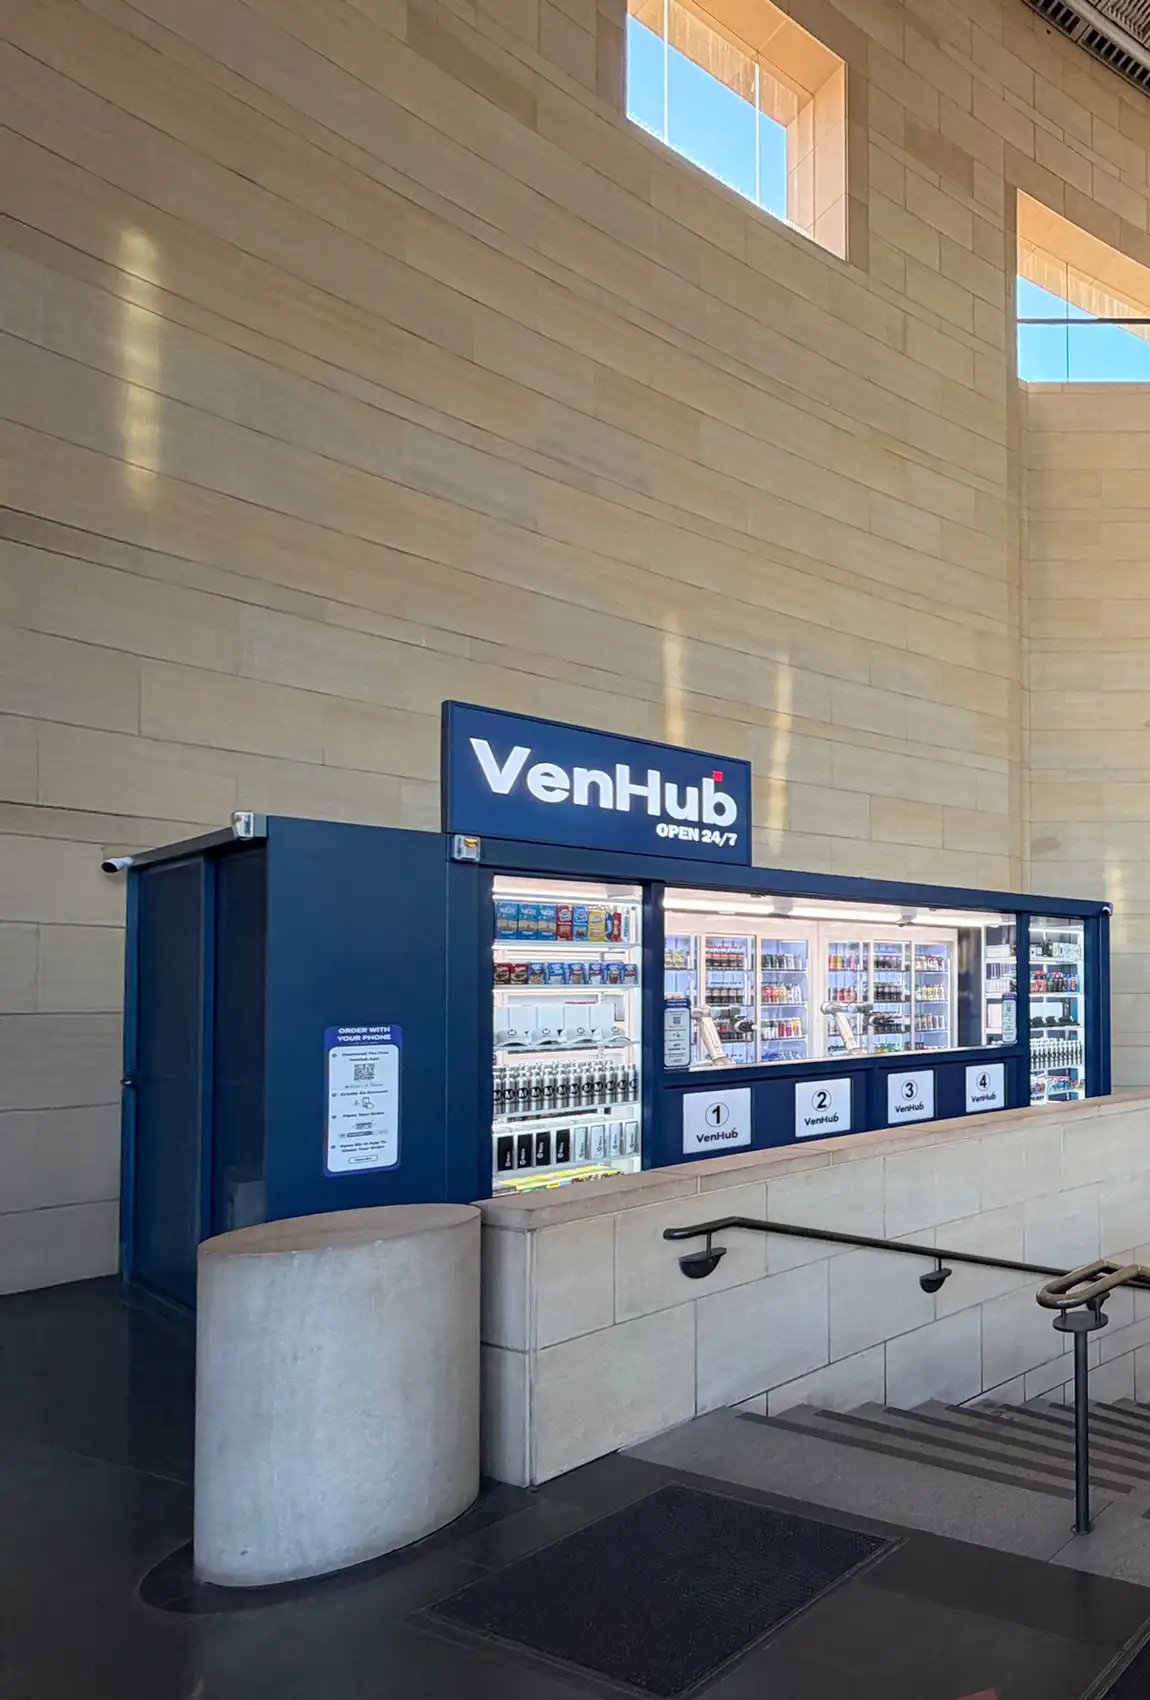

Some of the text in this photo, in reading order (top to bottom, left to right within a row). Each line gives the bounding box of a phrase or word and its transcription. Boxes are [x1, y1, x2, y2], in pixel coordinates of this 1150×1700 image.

[470, 737, 738, 827] VenHub
[656, 822, 738, 847] OPEN 24/7
[979, 1074, 987, 1088] 4
[905, 1082, 914, 1098] 3
[971, 1091, 997, 1103] VenHub
[816, 1091, 827, 1109] 2
[894, 1101, 925, 1113] VenHub
[711, 1106, 721, 1124] 1
[804, 1112, 840, 1127] VenHub
[696, 1127, 739, 1143] VenHub
